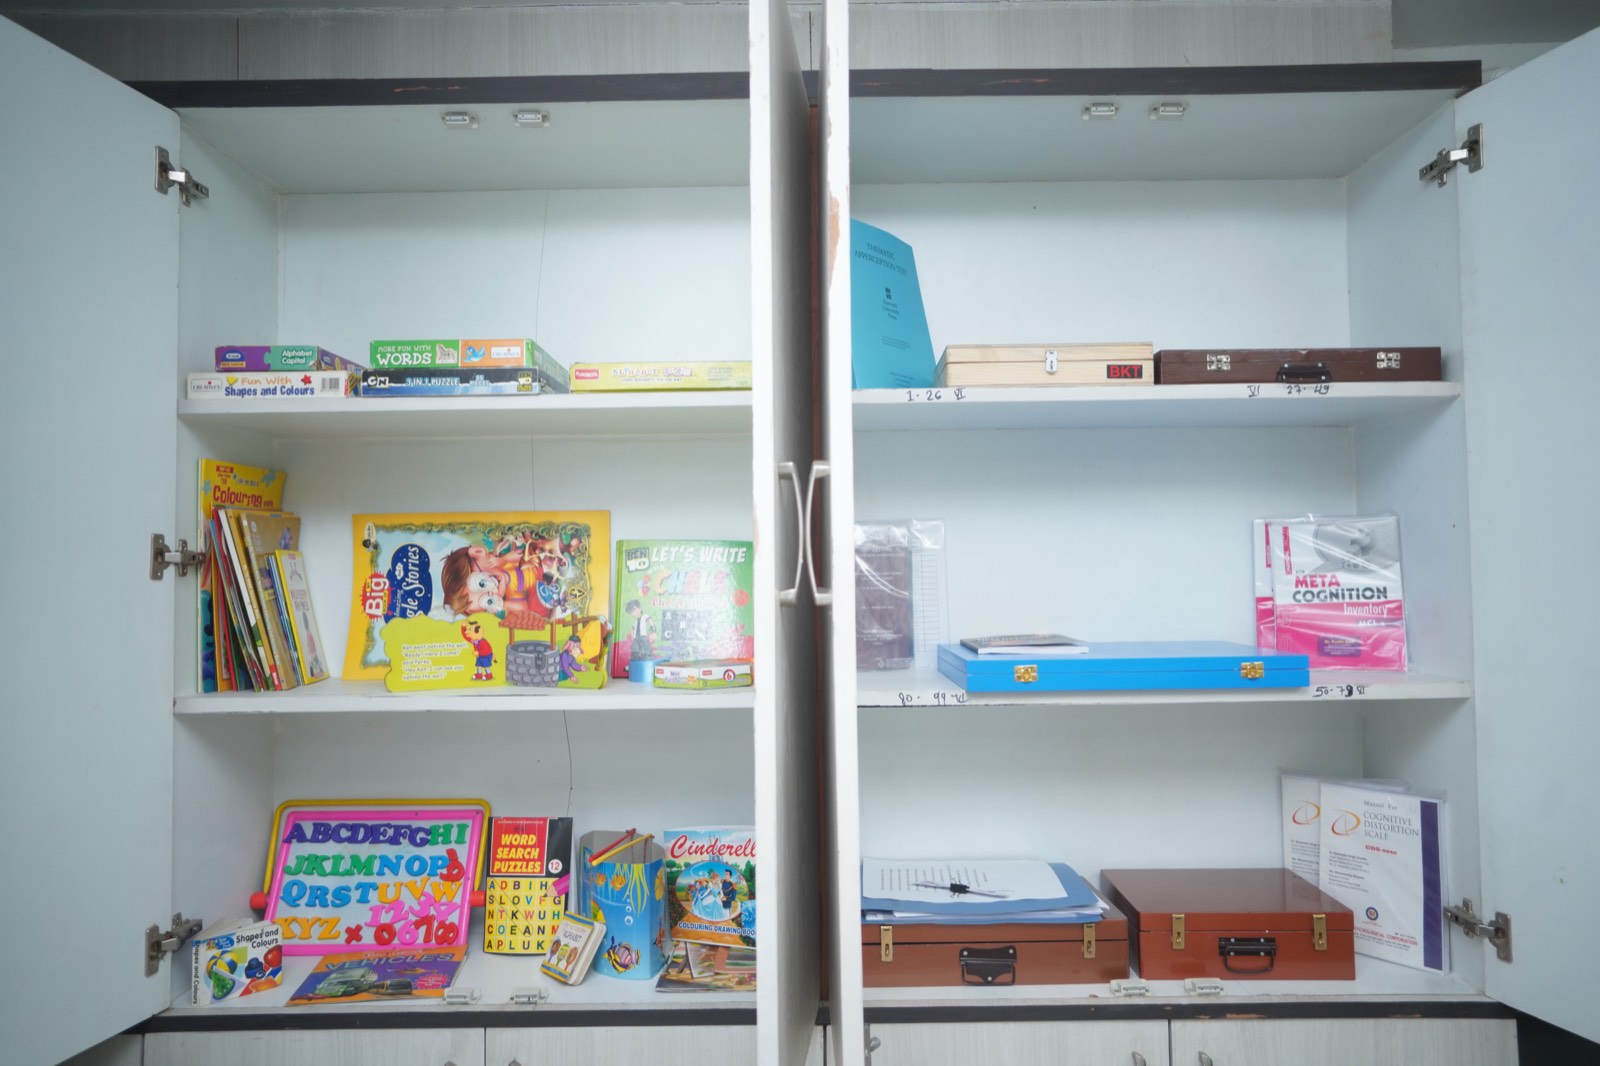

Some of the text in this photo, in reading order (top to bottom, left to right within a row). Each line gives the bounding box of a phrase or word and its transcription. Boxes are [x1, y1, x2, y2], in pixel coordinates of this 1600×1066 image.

[281, 357, 306, 365] Capital
[282, 350, 313, 359] Alphabet
[376, 352, 432, 366] WORDS
[1109, 365, 1141, 378] BKT
[241, 377, 292, 385] Fun With
[367, 375, 389, 388] CN
[412, 378, 422, 386] IN
[431, 378, 460, 386] PUZZLE
[225, 385, 315, 398] Shapes and Colours
[213, 485, 263, 507] Colouring
[627, 550, 647, 560] BEN
[652, 547, 747, 563] LET'S WRITE
[401, 545, 425, 597] Stories
[1294, 574, 1341, 589] META
[365, 577, 390, 617] Big
[1292, 586, 1388, 603] COGNITION
[1343, 603, 1388, 618] Inventory
[1363, 810, 1413, 826] COGNITIVE
[1364, 820, 1419, 836] DISTORTION
[1364, 829, 1389, 840] SCALE
[501, 834, 537, 846] WORD
[496, 847, 540, 859] SEARCH
[493, 861, 542, 873] PUZZLES
[550, 861, 560, 871] 12
[678, 922, 713, 931] COLOURING
[714, 925, 741, 935] DRAWING
[235, 931, 263, 944] Shapes
[264, 927, 279, 938] and
[251, 937, 279, 949] Colours
[325, 953, 455, 971] VEHICLES
[192, 980, 200, 1005] Colours
